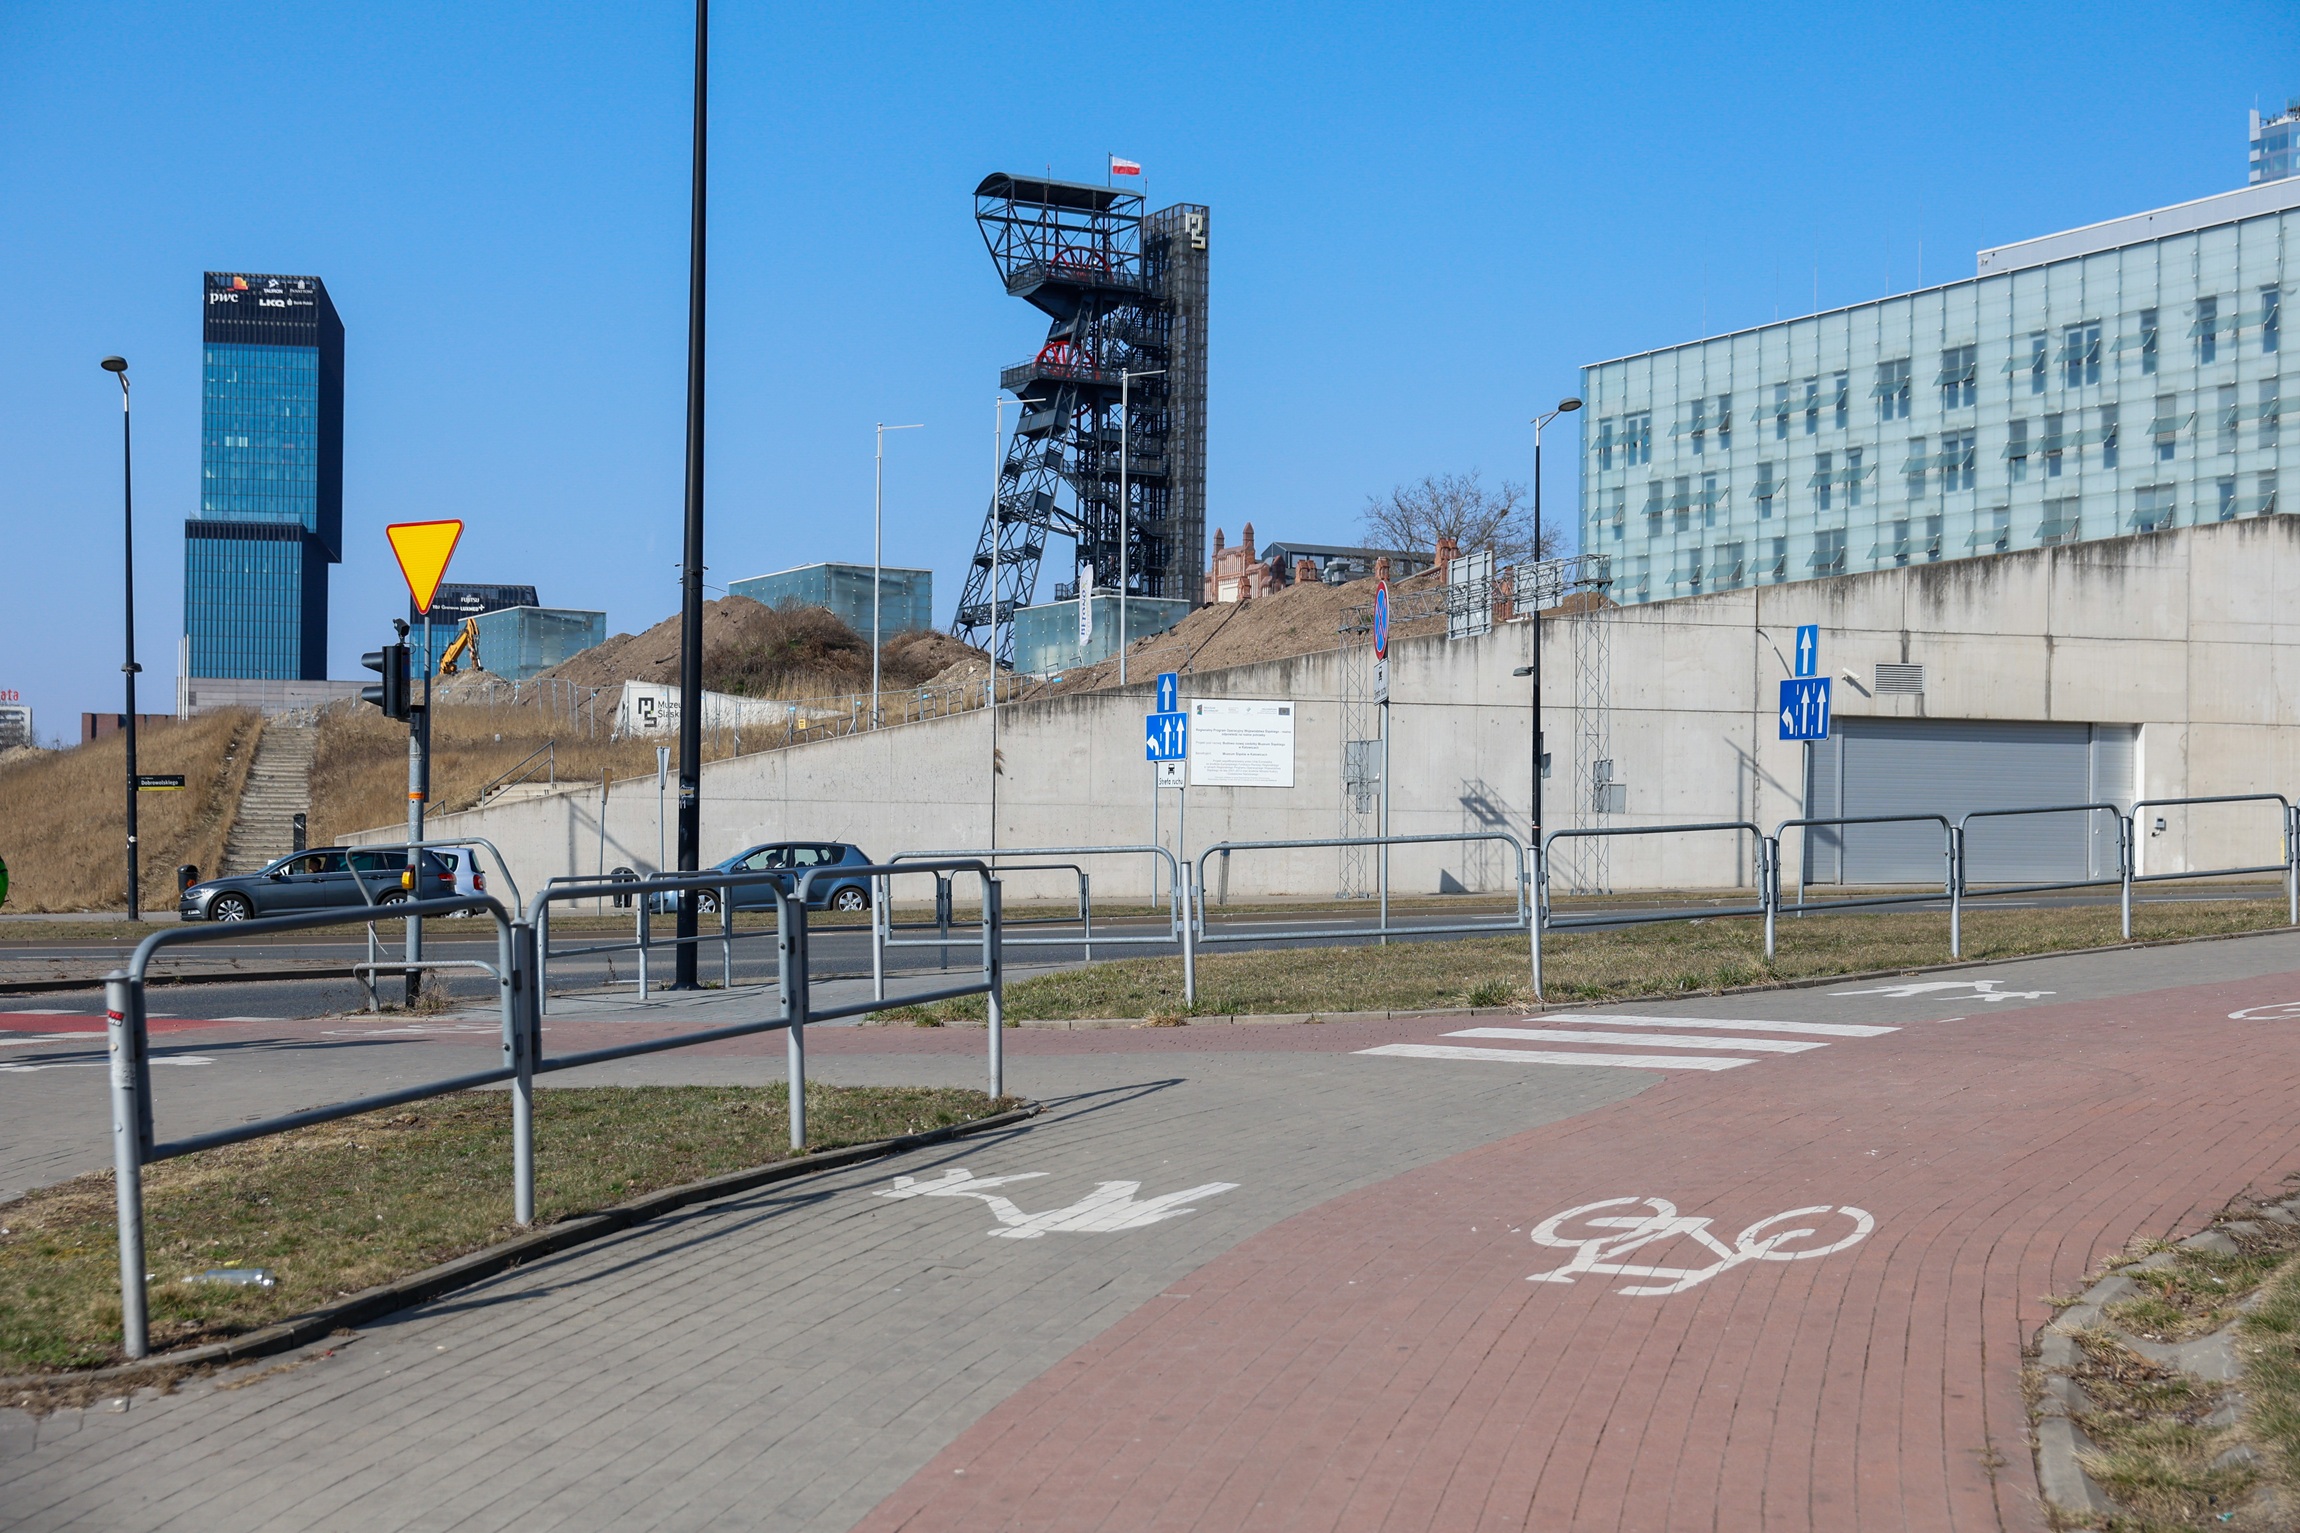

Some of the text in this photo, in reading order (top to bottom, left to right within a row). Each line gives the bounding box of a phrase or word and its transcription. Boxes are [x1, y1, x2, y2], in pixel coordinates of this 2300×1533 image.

[210, 293, 239, 304] pwc
[259, 298, 286, 308] LKQ
[658, 700, 681, 709] Muzeu
[658, 708, 681, 718] Śląsk
